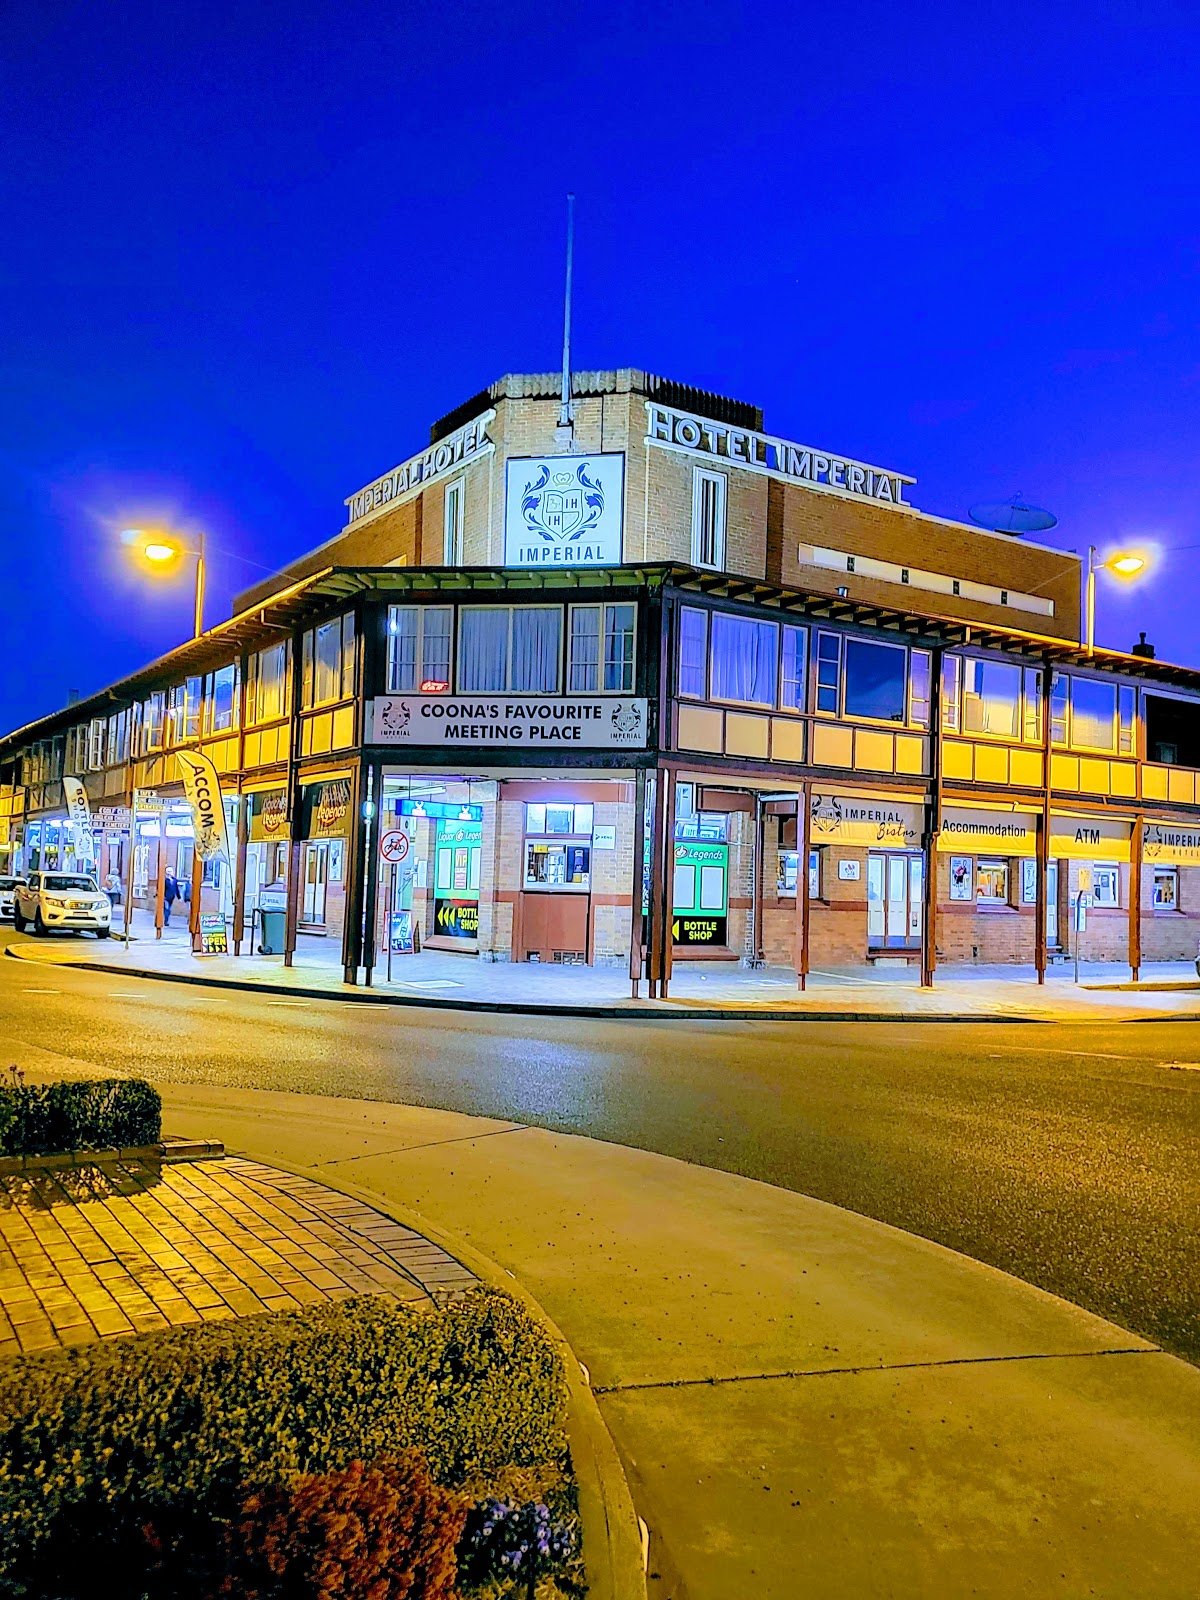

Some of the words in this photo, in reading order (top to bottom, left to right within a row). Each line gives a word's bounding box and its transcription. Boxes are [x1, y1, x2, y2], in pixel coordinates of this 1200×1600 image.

[650, 407, 767, 468] HOTEL
[779, 443, 911, 507] IMPERIAL
[352, 460, 420, 523] IMPERIAL
[422, 422, 489, 480] HOTEL
[565, 498, 578, 509] IH
[548, 515, 561, 526] IH
[519, 545, 605, 562] IMPERIAL
[421, 703, 499, 719] COONA'S
[505, 705, 602, 719] FAVOURITE
[444, 724, 523, 739] MEETING
[529, 725, 581, 740] PLACE
[193, 765, 215, 829] ACCOM
[76, 788, 89, 835] BOTTLE
[316, 805, 347, 820] Legends
[845, 808, 901, 822] IMPERIAL
[942, 818, 1026, 838] Accommodation
[438, 830, 455, 844] Liquor
[1074, 828, 1100, 845] ATM
[456, 855, 467, 867] VIP
[688, 849, 723, 861] Legends
[460, 918, 479, 931] SHOP
[684, 921, 717, 931] BOTTLE
[202, 937, 227, 946] OPEN
[688, 930, 712, 940] SHOP
